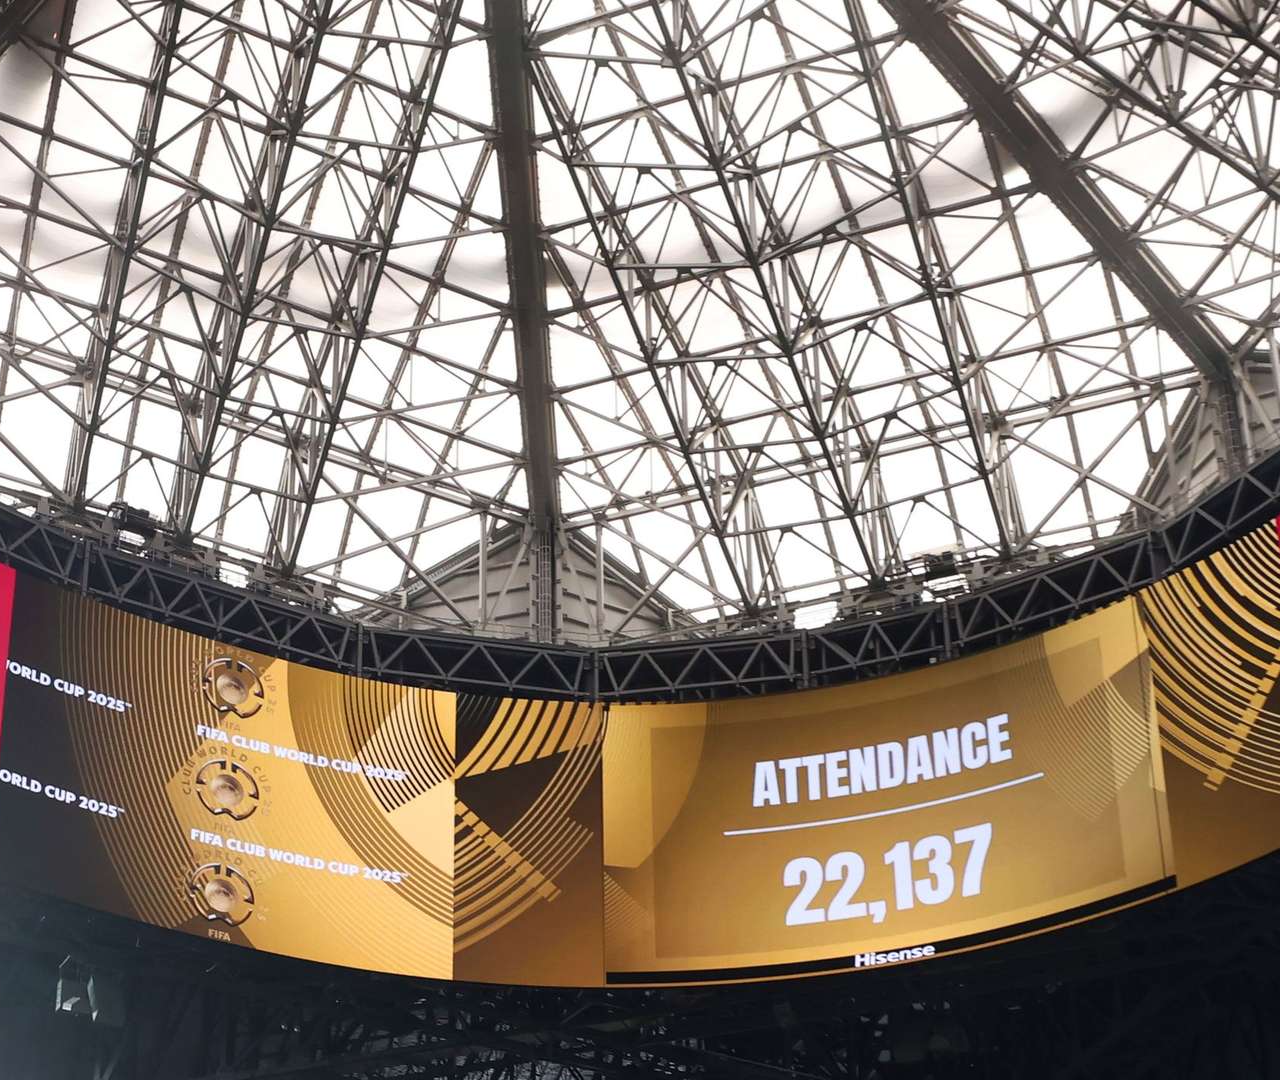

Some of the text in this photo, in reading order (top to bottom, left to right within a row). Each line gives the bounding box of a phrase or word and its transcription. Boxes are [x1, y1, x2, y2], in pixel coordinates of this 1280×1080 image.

[53, 679, 85, 698] CUP
[197, 724, 228, 744] FIFA
[231, 734, 270, 754] CLUB
[273, 745, 331, 767] WORLD
[331, 758, 362, 774] CUP
[753, 713, 1012, 807] ATTENDANCE
[44, 786, 76, 804] CUP
[191, 828, 224, 848] FIFA
[226, 838, 266, 858] CLUB
[269, 848, 326, 870] WORLD
[328, 860, 360, 875] CUP
[782, 823, 993, 926] 22,137
[854, 943, 936, 967] Hisense
